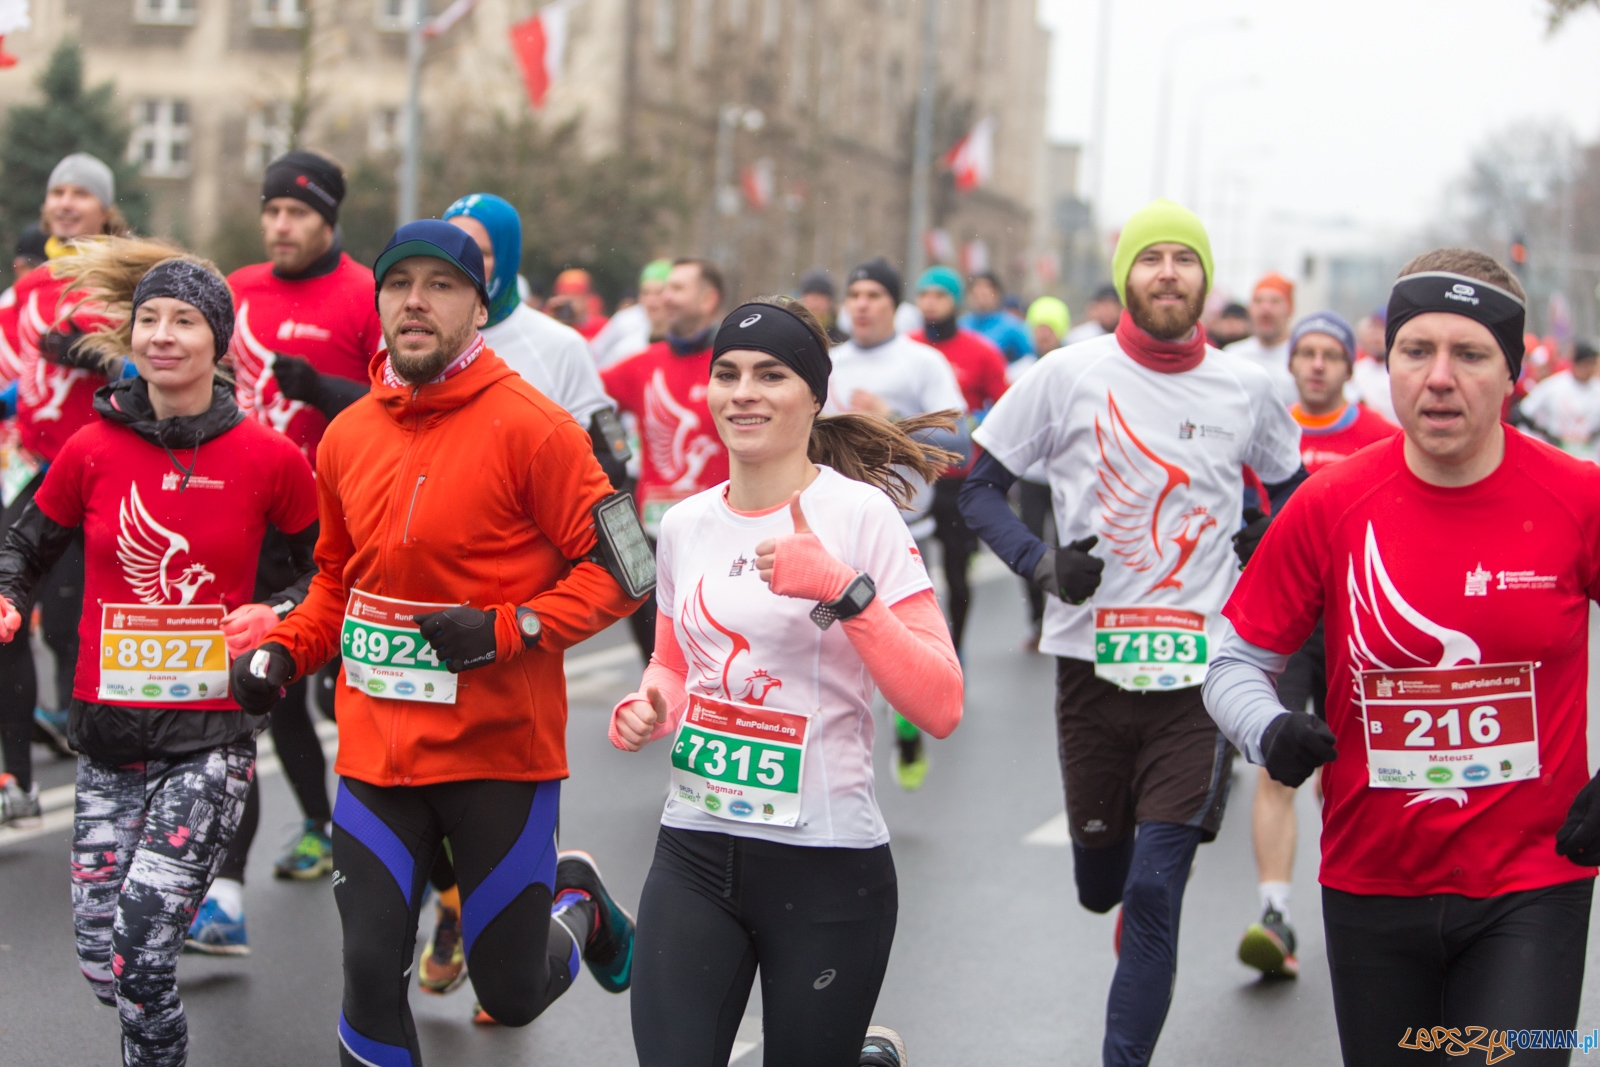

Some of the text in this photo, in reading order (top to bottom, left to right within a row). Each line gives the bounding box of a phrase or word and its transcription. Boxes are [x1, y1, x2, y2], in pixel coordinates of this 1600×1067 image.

[1496, 570, 1507, 590] 1
[166, 617, 218, 626] RunPoland.org
[105, 637, 213, 668] D 8927
[344, 627, 440, 668] C 8924
[1109, 633, 1198, 662] 7193
[371, 667, 404, 678] Tomasz
[1397, 680, 1406, 694] 1
[1451, 676, 1521, 691] RunPoland.org
[735, 718, 796, 737] RunPoland.org
[1370, 705, 1501, 747] B 216
[675, 734, 785, 786] C 7315
[1429, 754, 1474, 763] Mateusz
[1378, 767, 1402, 776] GRUPA
[1378, 774, 1408, 783] LUXMED
[706, 781, 744, 796] Dagmara
